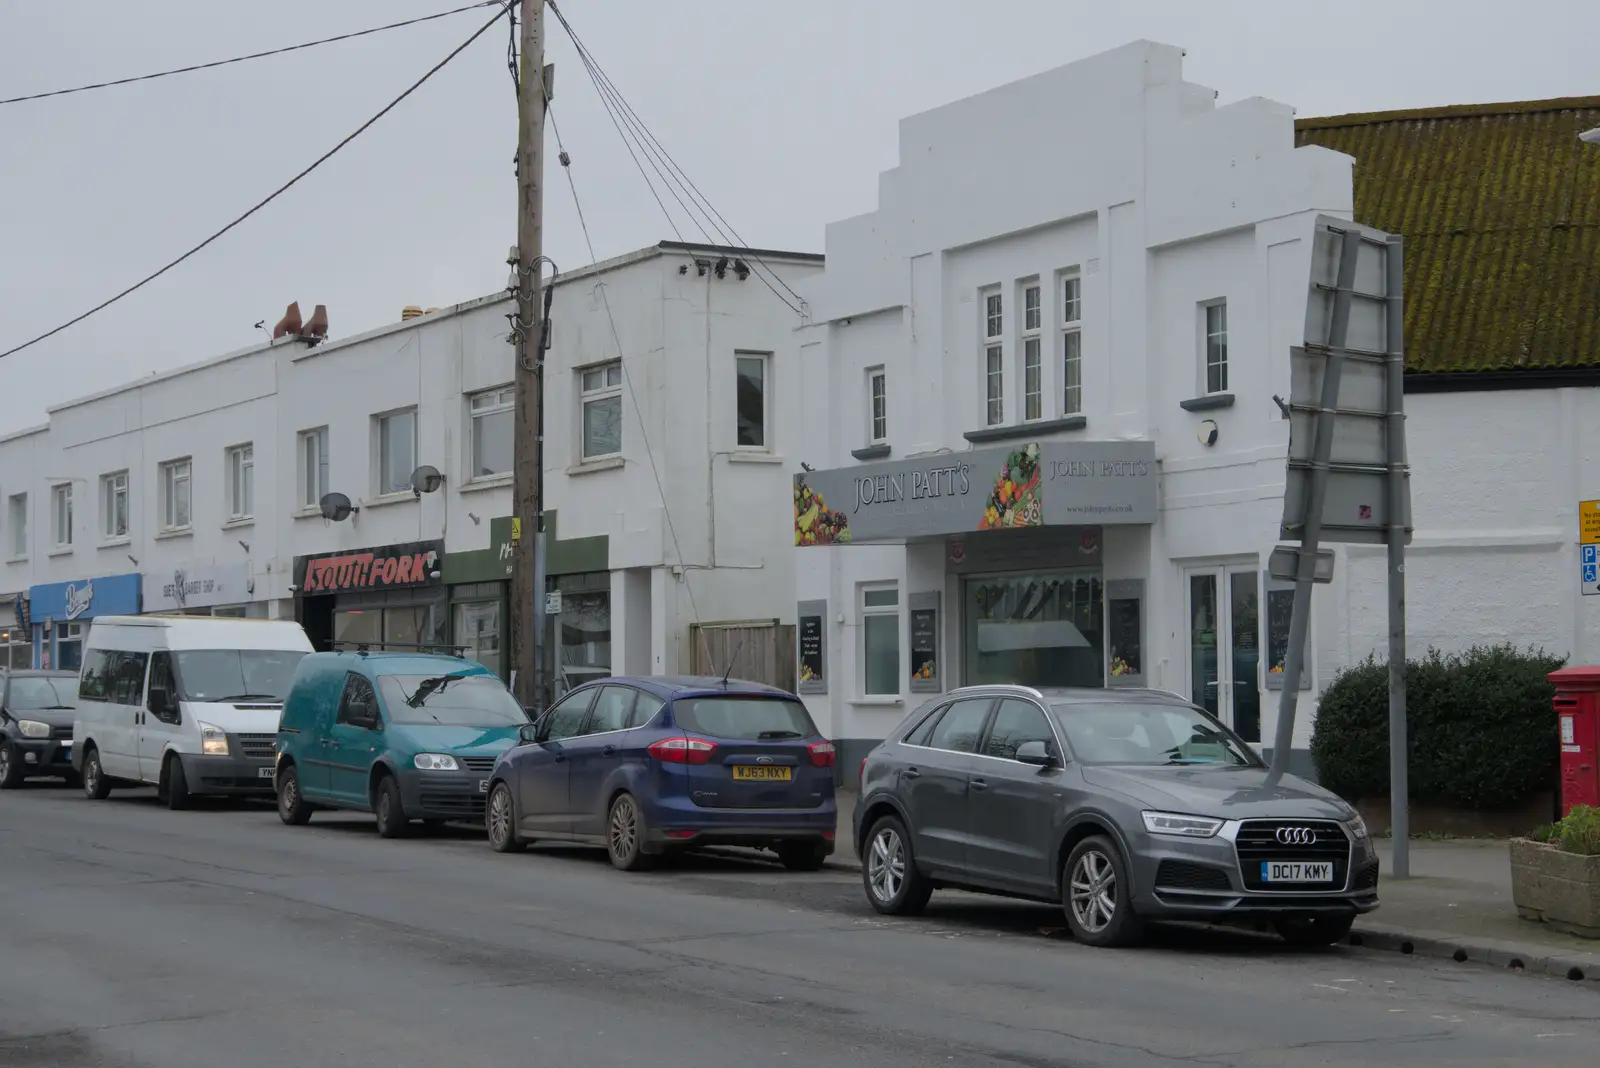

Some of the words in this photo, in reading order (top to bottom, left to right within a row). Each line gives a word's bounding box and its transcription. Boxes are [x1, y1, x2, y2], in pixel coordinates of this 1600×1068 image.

[1050, 460, 1095, 481] JOHN
[1100, 459, 1148, 477] PATT'S
[853, 473, 904, 514] JOHN
[911, 460, 969, 500] PATT'S
[1585, 548, 1593, 562] P
[738, 767, 765, 778] WJ63
[767, 767, 787, 778] NXY
[1272, 864, 1301, 879] DC17
[1304, 864, 1328, 879] KMY
